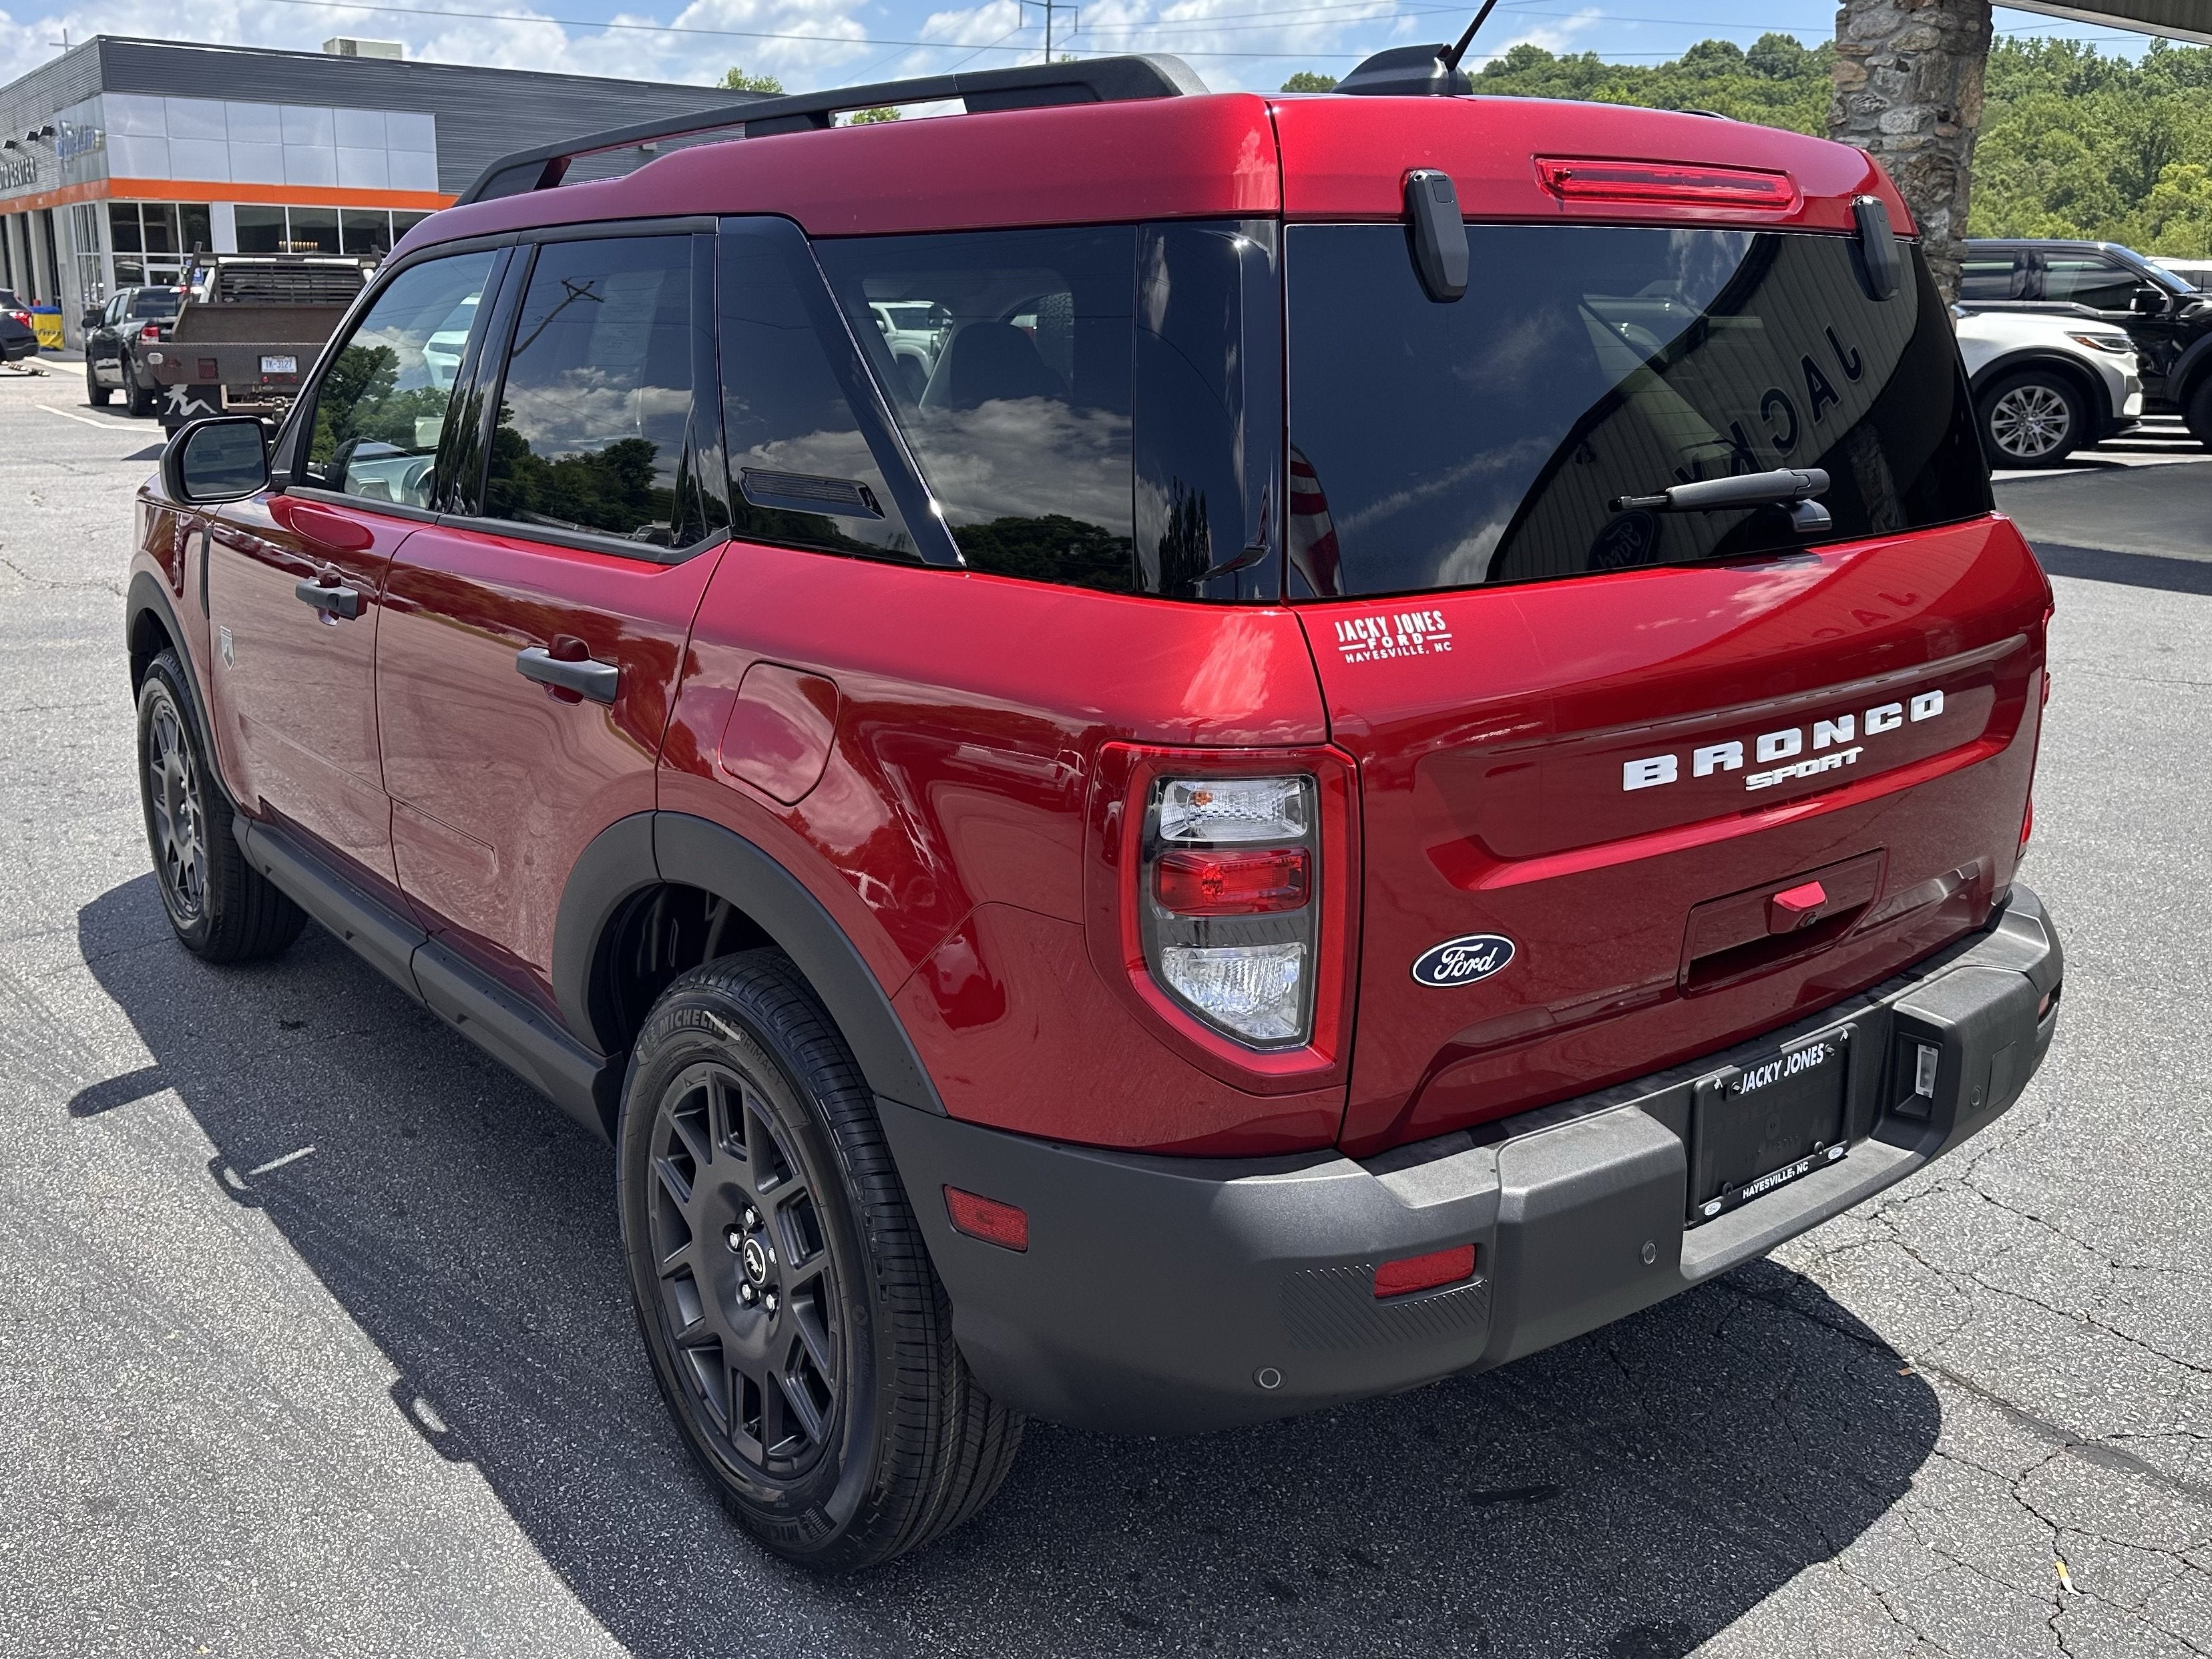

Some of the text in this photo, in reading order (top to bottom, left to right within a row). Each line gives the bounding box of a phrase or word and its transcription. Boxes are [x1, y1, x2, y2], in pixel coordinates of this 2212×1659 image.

[1335, 610, 1446, 642] JACKY JONES
[1367, 632, 1423, 650] FORD
[1345, 641, 1452, 663] HAYESVILLE, NC
[1622, 690, 1944, 792] BRONCO
[1745, 746, 1864, 792] SPORT
[1433, 943, 1499, 980] Ford
[1740, 1043, 1825, 1095] JACKY JONES
[1743, 1161, 1809, 1199] HAYESVILLE, NC
